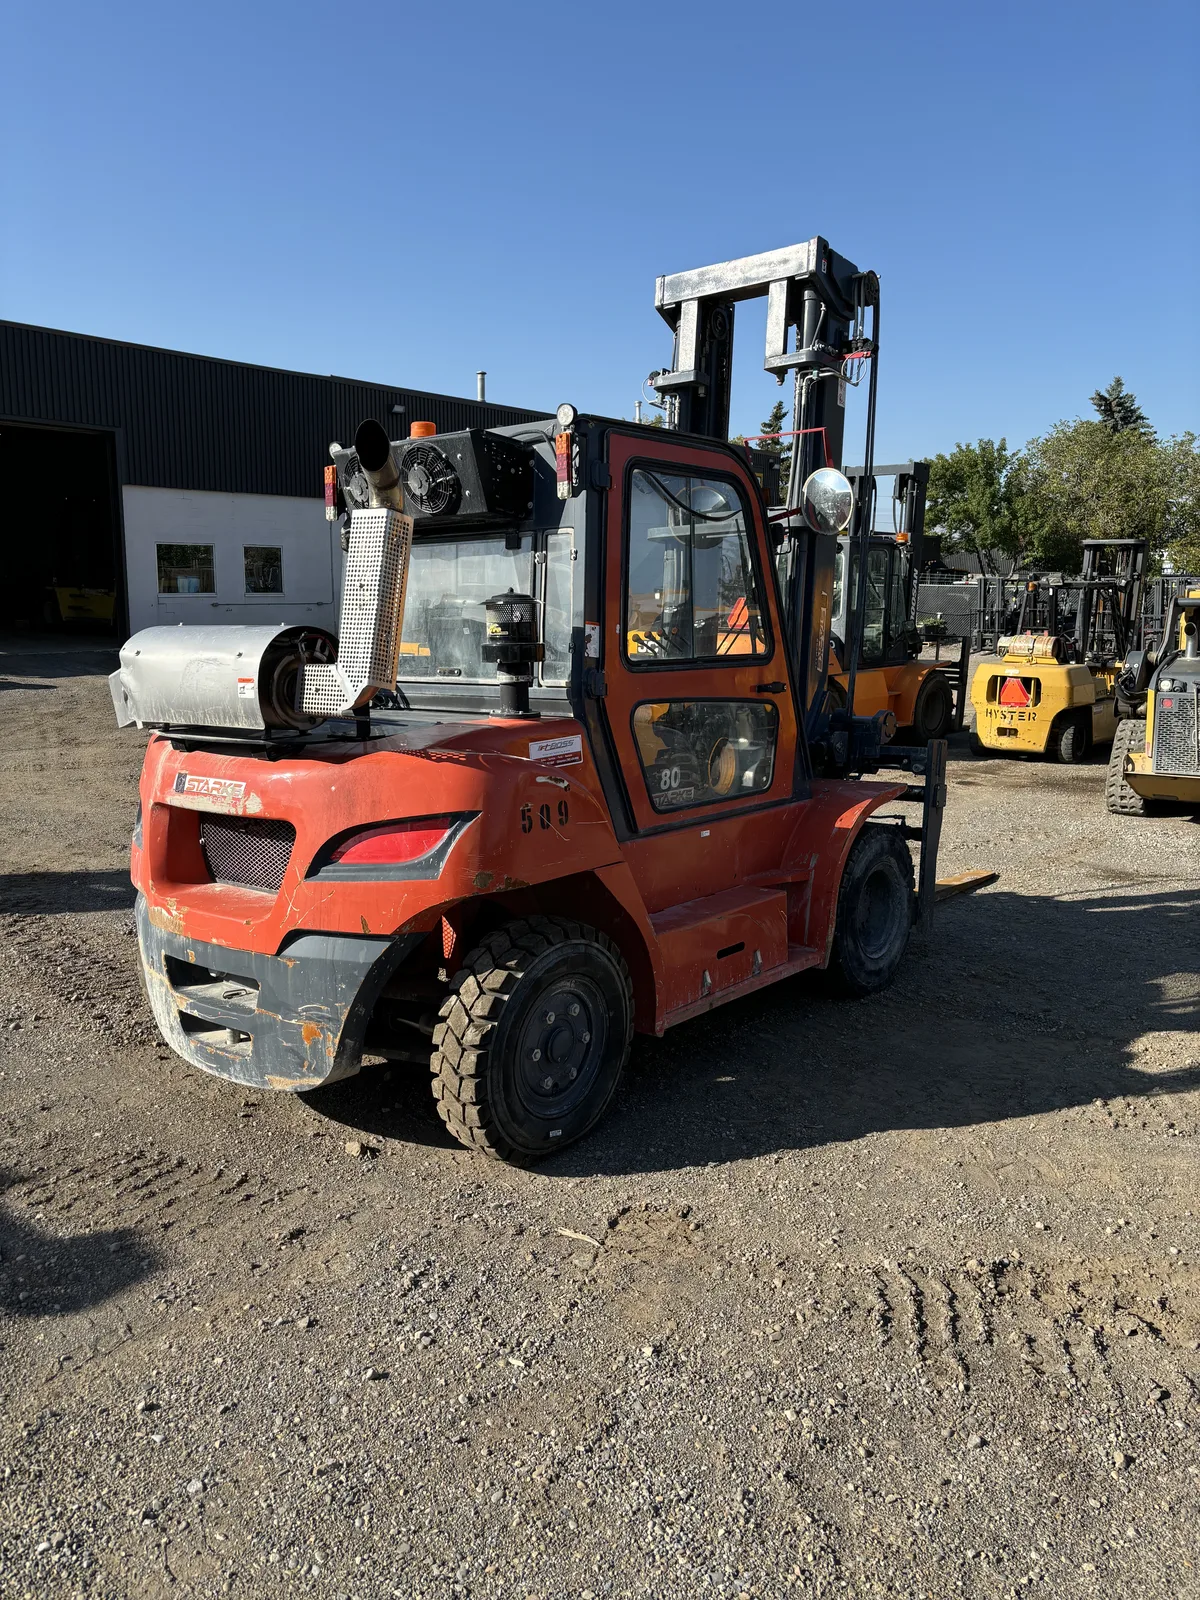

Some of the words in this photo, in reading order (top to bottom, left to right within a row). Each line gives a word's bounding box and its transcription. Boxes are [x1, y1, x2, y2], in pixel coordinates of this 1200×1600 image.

[985, 708, 1038, 722] HYSTER
[660, 765, 681, 790] 80
[520, 799, 569, 834] 509
